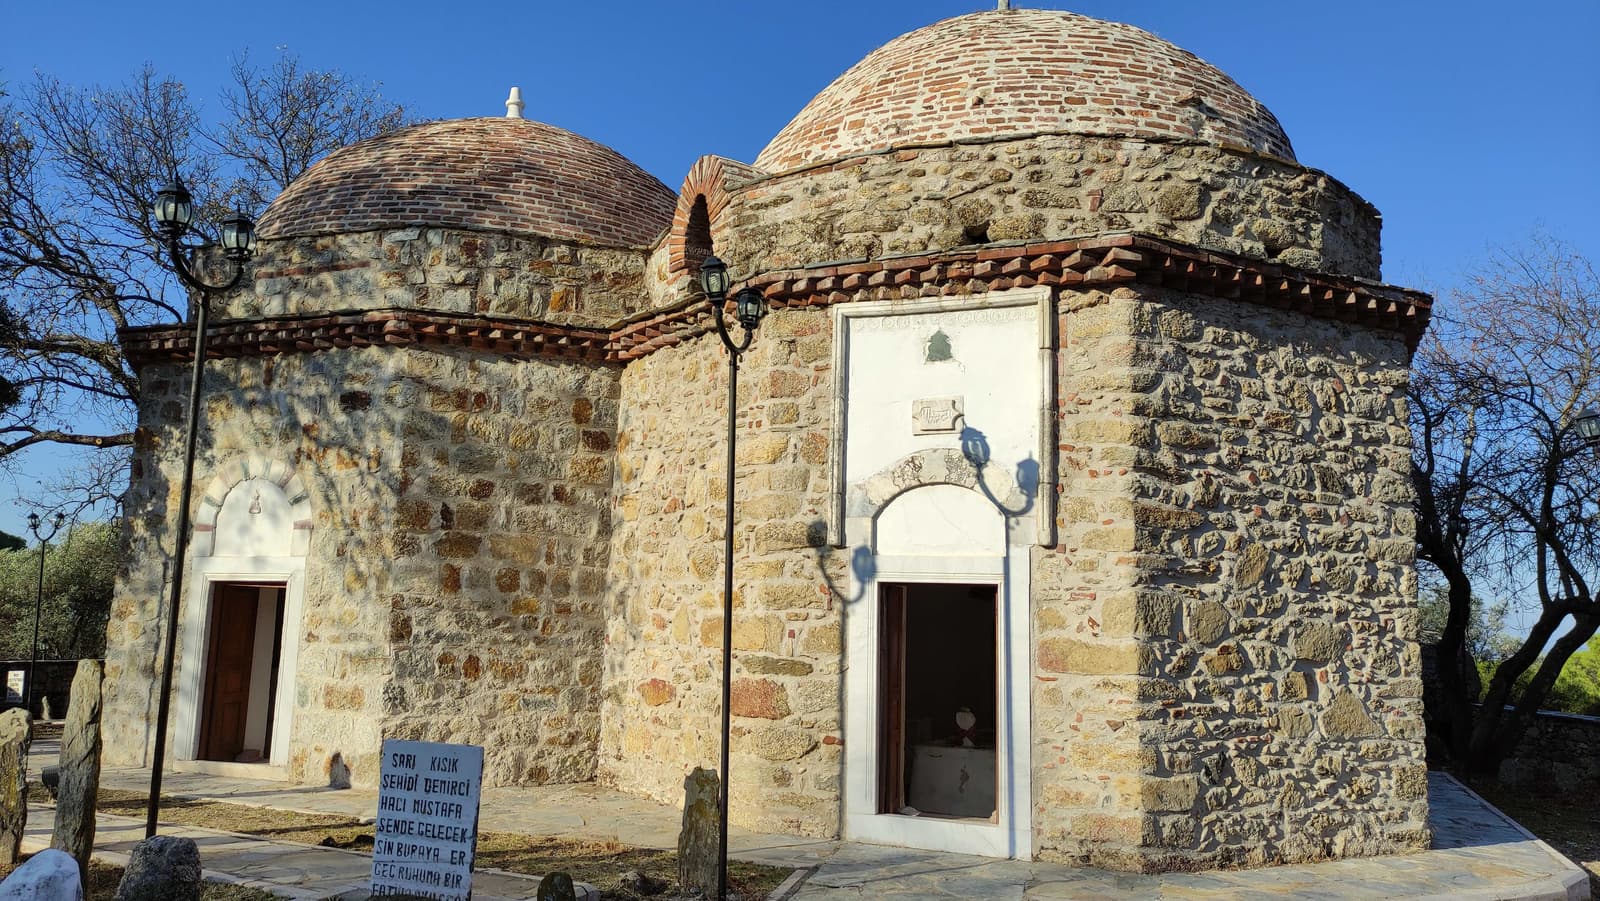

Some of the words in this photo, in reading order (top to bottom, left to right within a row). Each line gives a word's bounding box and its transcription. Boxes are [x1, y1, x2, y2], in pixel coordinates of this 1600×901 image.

[392, 752, 417, 770] SARI
[430, 756, 459, 773] KISIK
[380, 795, 407, 812] HACI
[412, 799, 463, 819] MUSTAFA
[378, 817, 414, 836] SENDE
[418, 821, 468, 844] GELECEK
[396, 842, 440, 863] BURAYA
[450, 850, 466, 867] ER
[398, 866, 441, 887] RUHUMA
